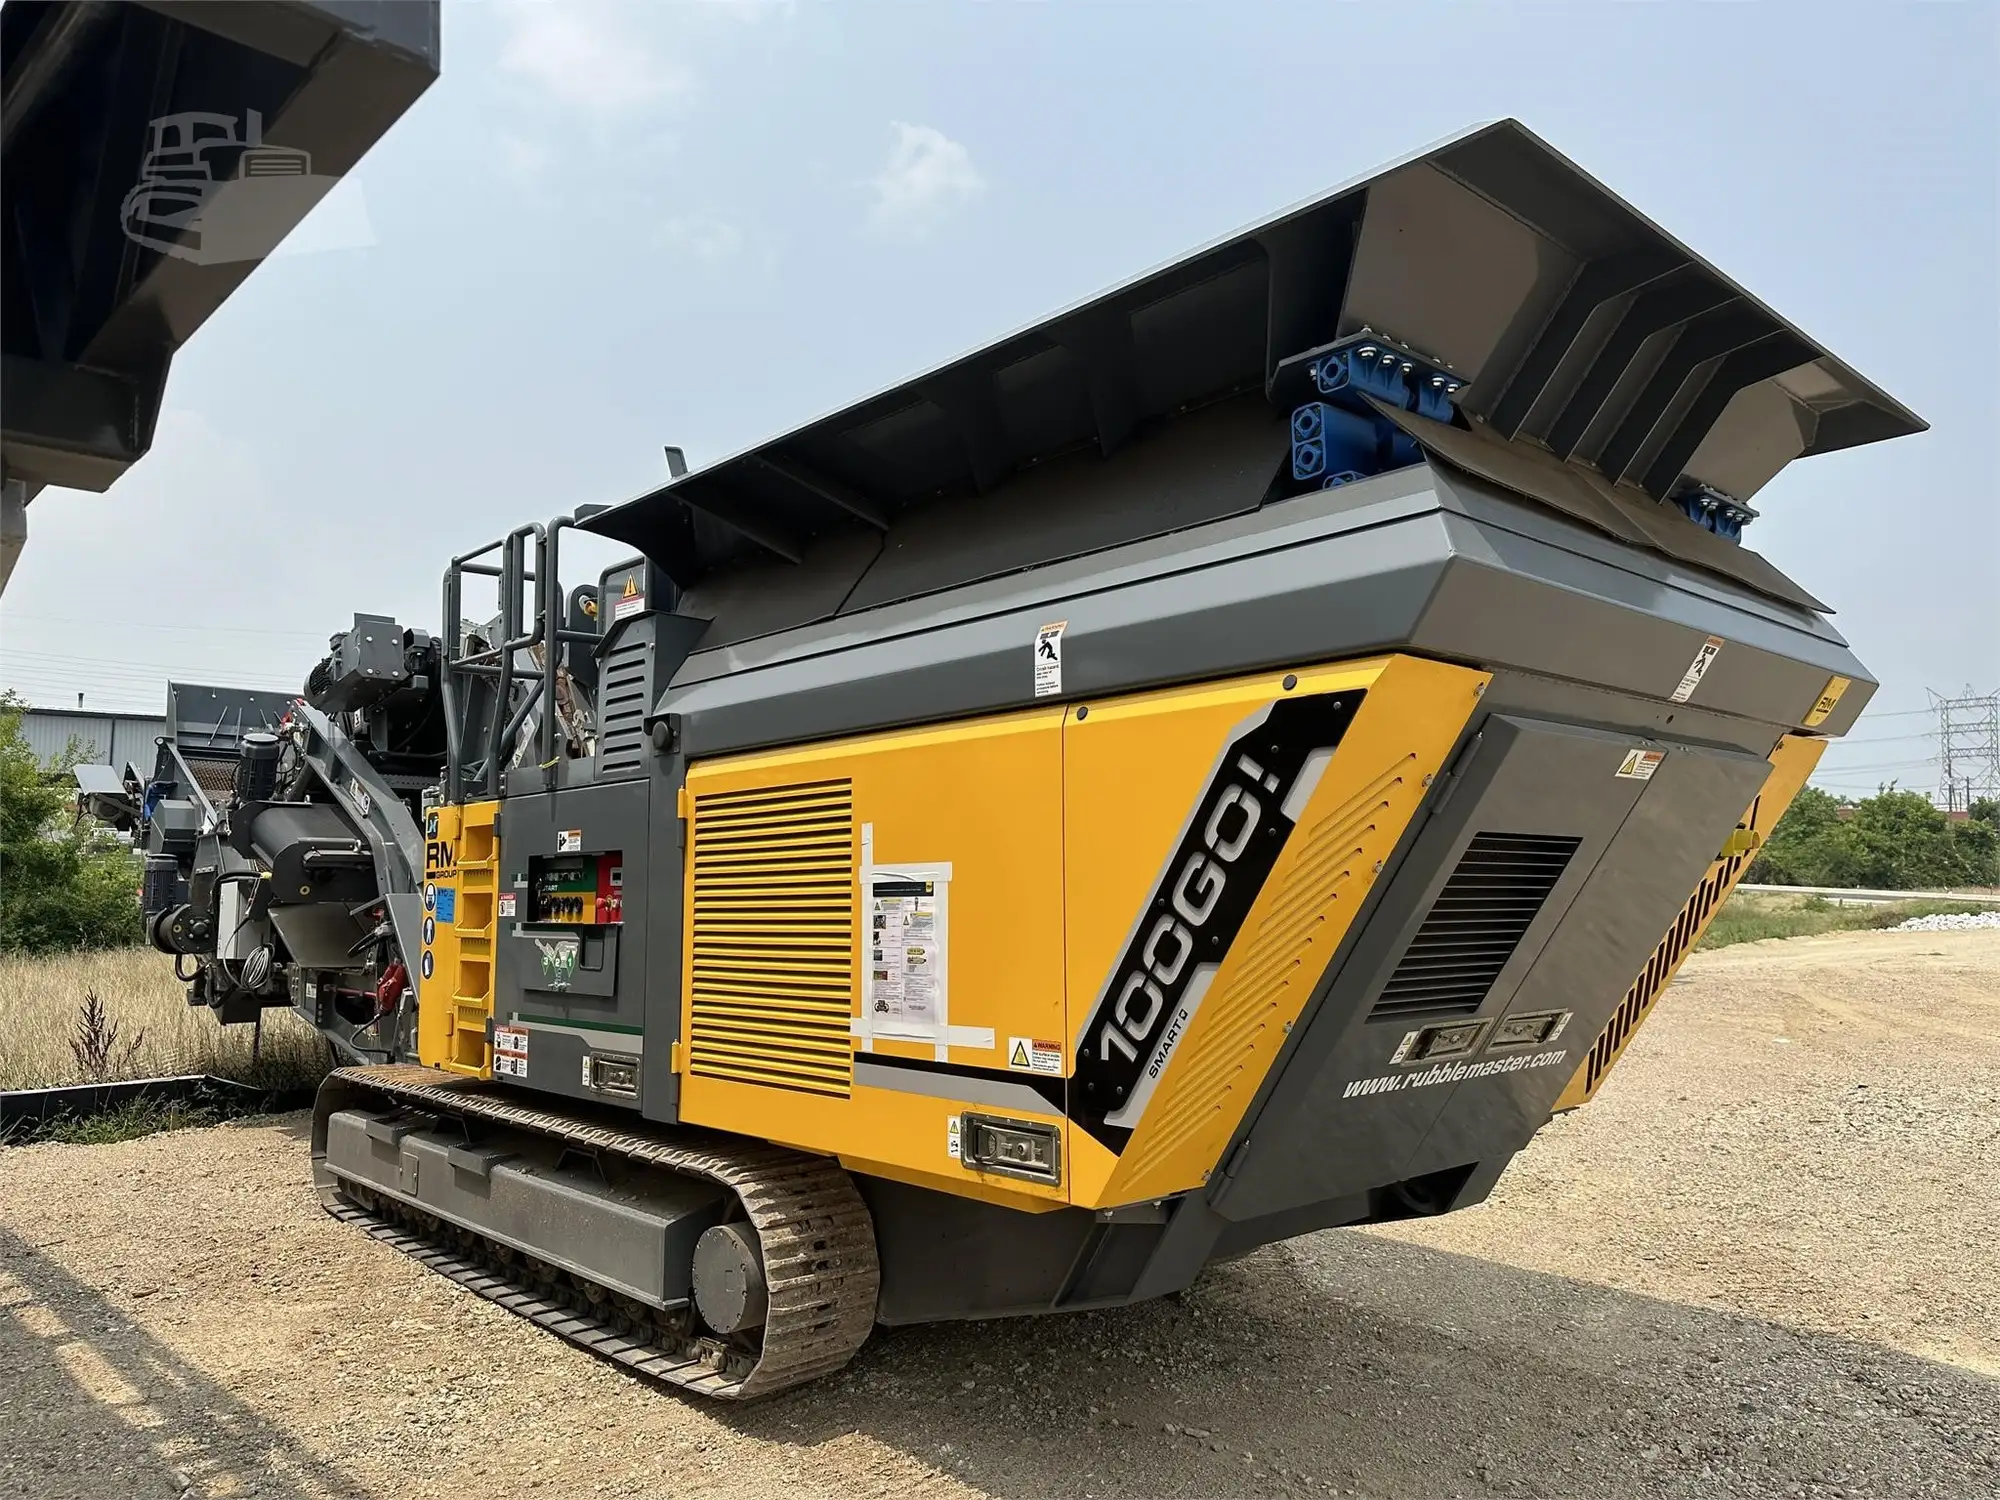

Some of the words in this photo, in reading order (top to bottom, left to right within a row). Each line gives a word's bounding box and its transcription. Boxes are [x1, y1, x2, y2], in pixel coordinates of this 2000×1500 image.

[1818, 697, 1836, 709] RM
[435, 870, 457, 879] GROUP
[1101, 753, 1280, 1063] 100GO!
[543, 957, 549, 966] 3
[555, 958, 561, 967] 2
[568, 957, 572, 967] 1
[1037, 1042, 1061, 1050] WARNING
[1342, 1050, 1567, 1098] www.rubblemaster.com
